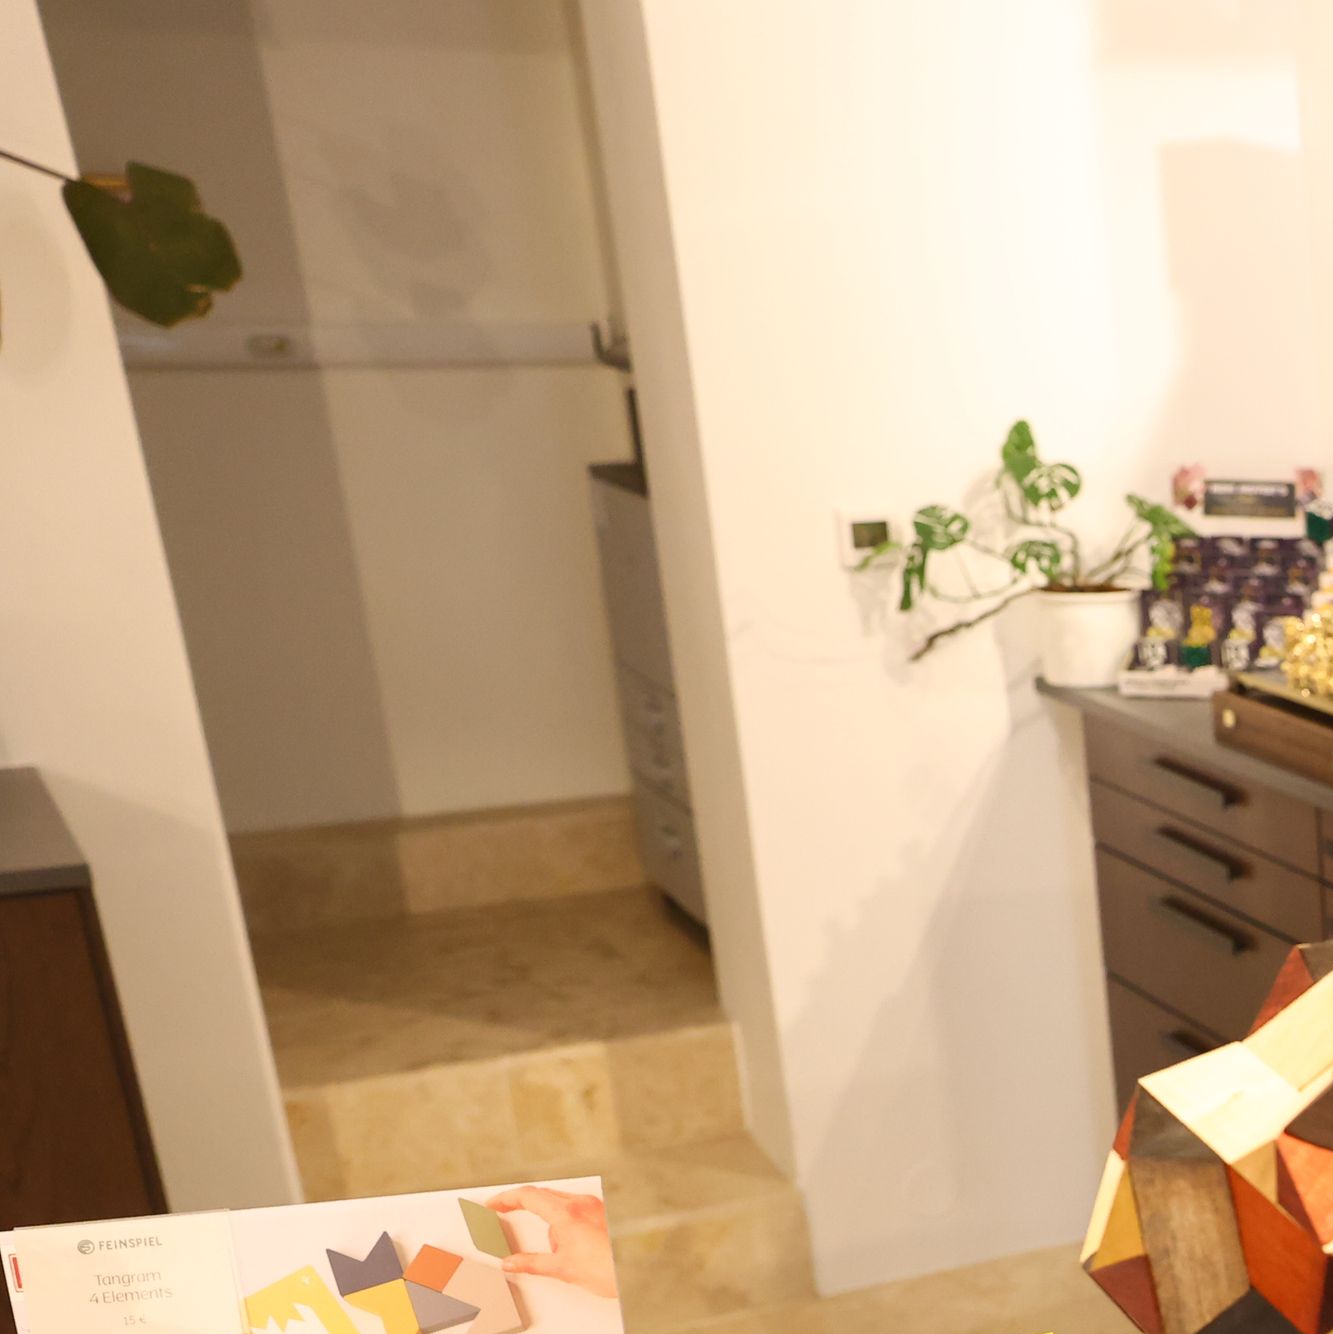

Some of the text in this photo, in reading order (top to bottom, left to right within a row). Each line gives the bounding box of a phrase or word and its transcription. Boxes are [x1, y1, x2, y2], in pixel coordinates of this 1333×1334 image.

[98, 1236, 163, 1251] FEINSPIEL
[95, 1271, 162, 1288] Tangram
[89, 1287, 174, 1304] 4 Elements
[123, 1313, 147, 1326] 15 €
